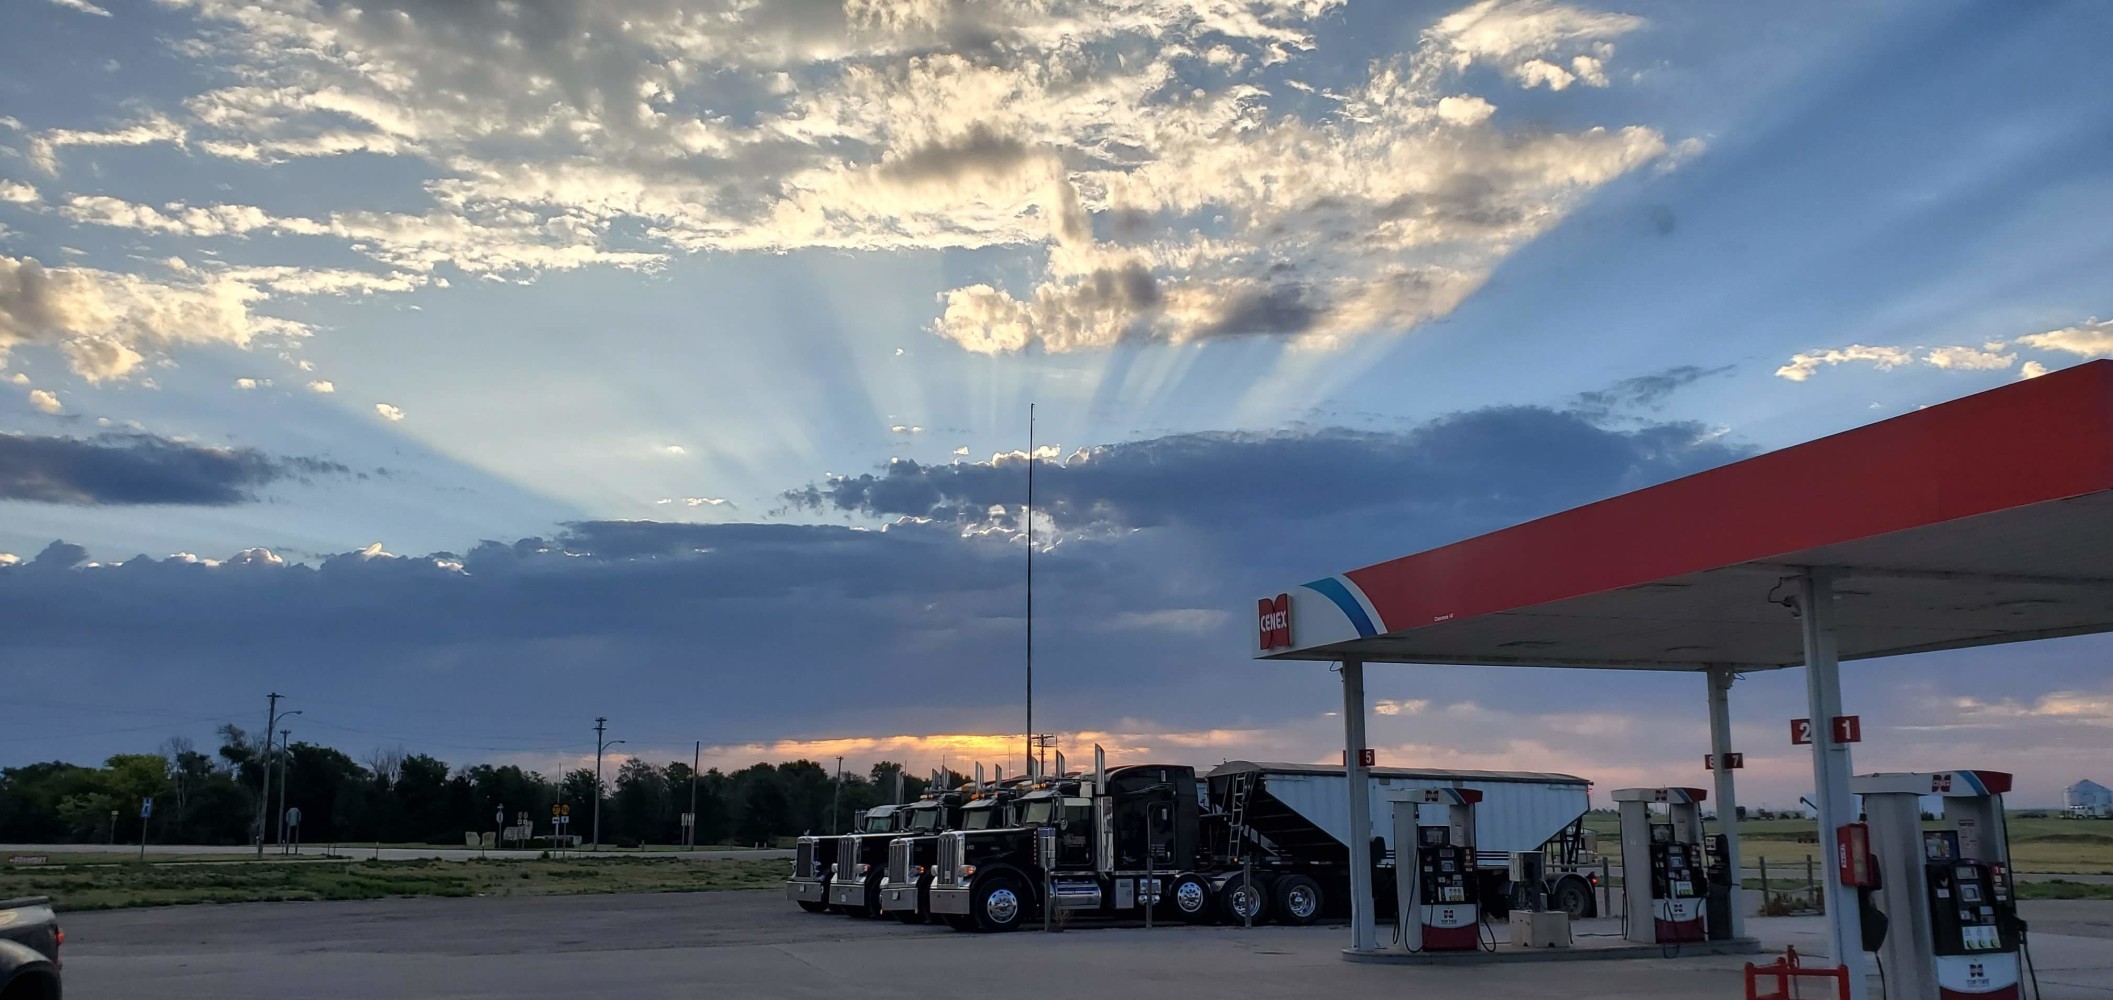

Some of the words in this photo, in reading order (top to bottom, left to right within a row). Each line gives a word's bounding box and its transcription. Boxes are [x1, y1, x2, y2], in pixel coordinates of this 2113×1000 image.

[1260, 609, 1287, 632] CENEX
[1799, 722, 1812, 742] 2
[1842, 719, 1851, 740] 1
[1365, 750, 1372, 764] 5
[1732, 754, 1740, 767] 7
